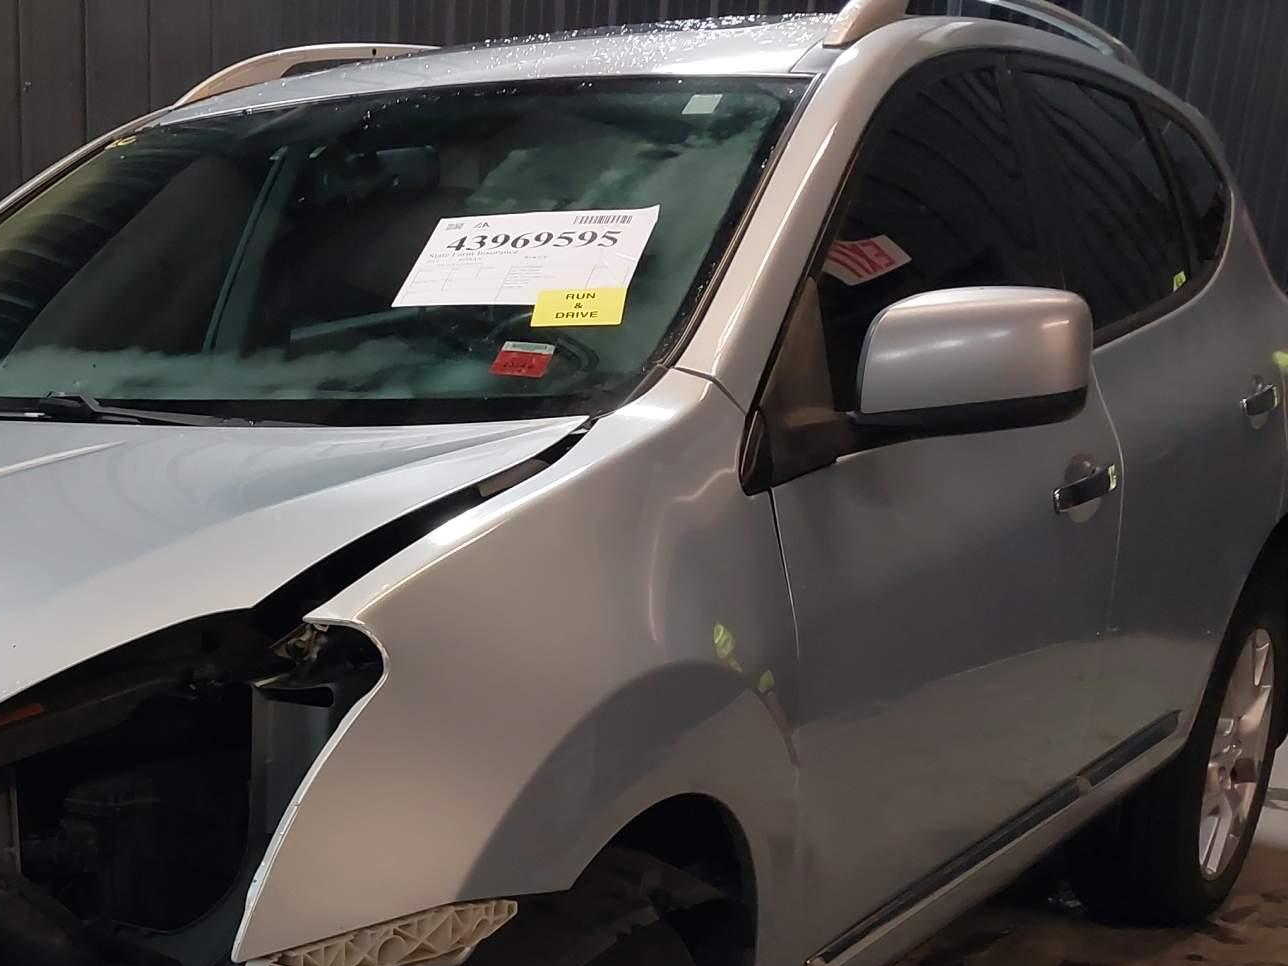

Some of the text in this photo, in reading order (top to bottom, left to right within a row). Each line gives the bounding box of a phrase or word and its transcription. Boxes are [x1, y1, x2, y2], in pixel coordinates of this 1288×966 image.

[446, 230, 622, 251] 43969595
[565, 292, 597, 300] RUN
[555, 310, 599, 319] DRIVE
